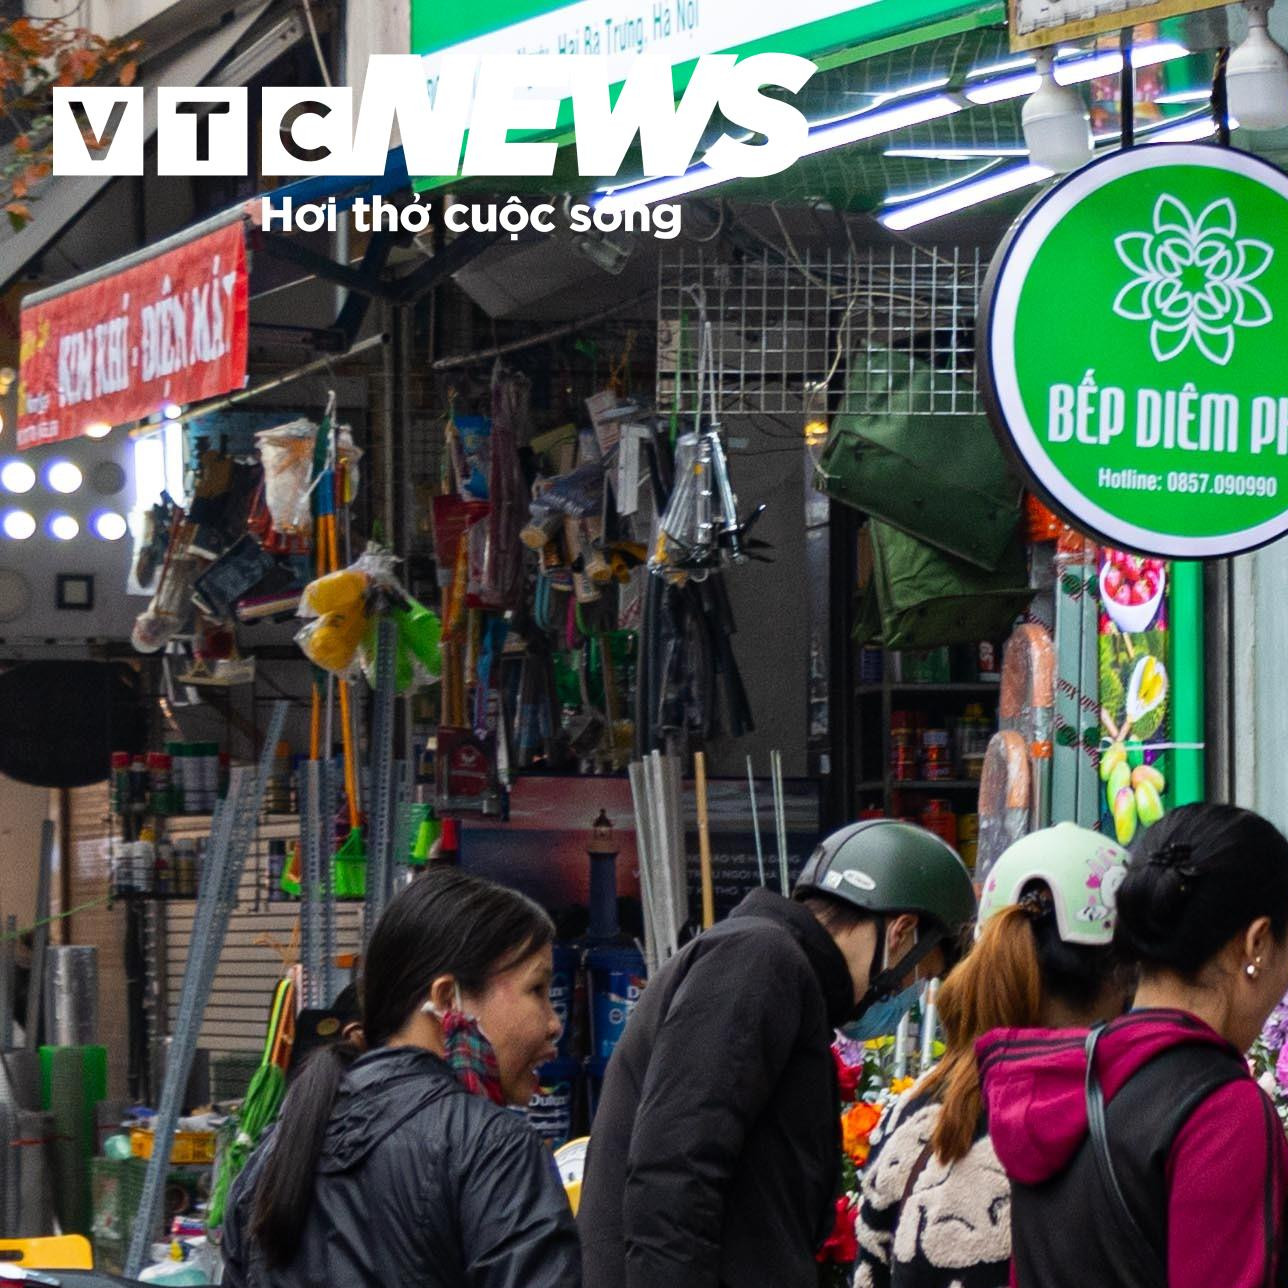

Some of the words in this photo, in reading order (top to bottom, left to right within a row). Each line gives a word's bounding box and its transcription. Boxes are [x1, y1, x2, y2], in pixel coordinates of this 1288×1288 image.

[1048, 369, 1126, 445] BẾP
[1135, 382, 1239, 453] DIÊM
[1098, 467, 1163, 492] Hotline:
[1167, 471, 1278, 497] 0857.090990
